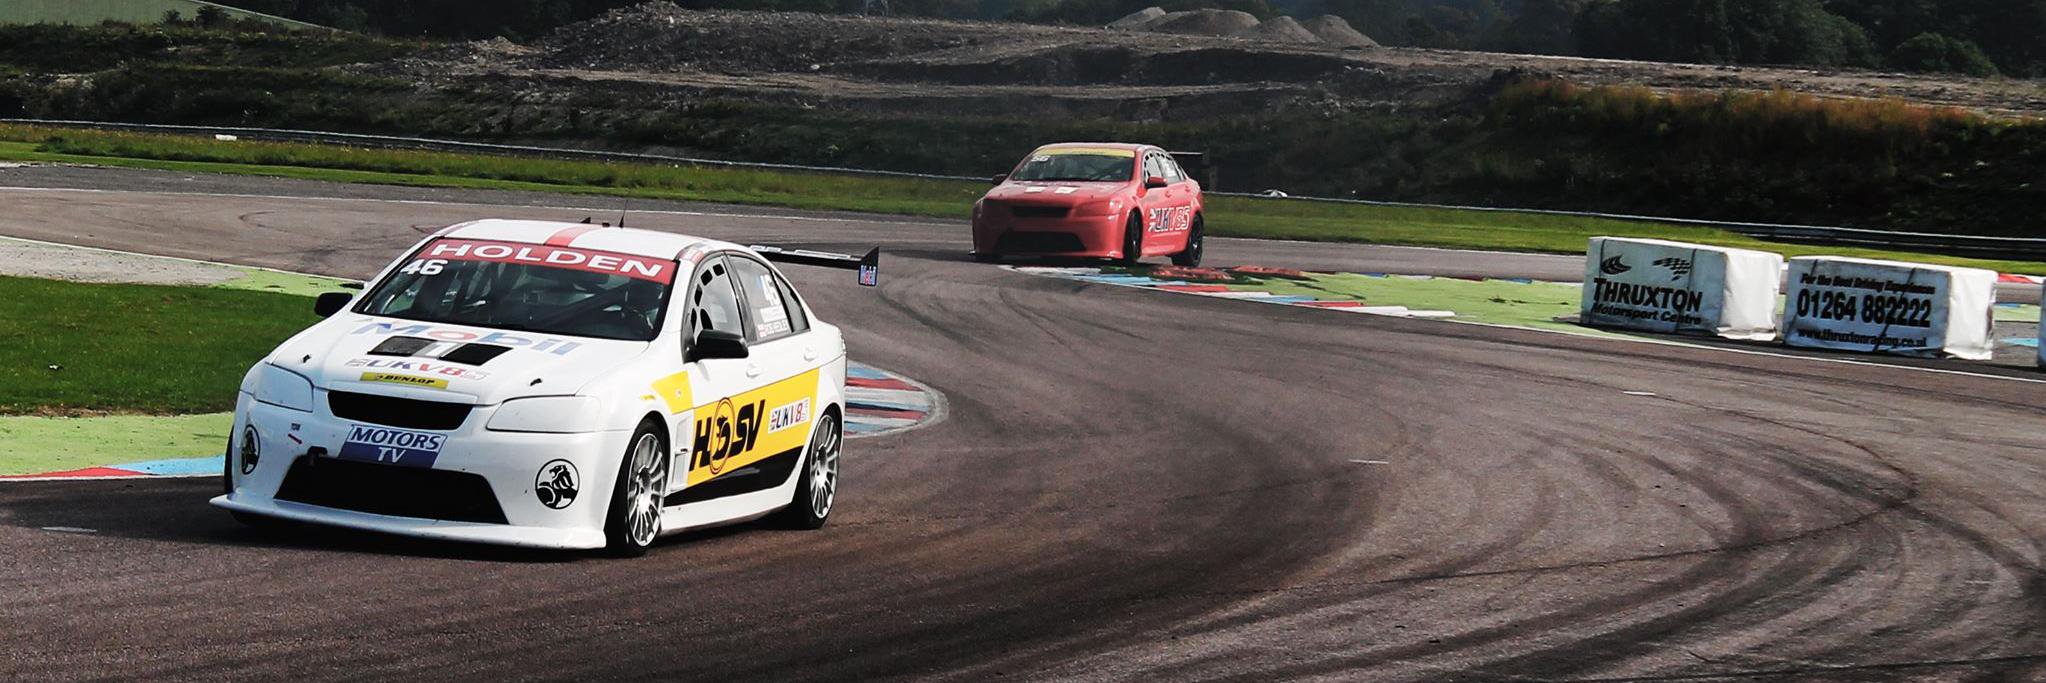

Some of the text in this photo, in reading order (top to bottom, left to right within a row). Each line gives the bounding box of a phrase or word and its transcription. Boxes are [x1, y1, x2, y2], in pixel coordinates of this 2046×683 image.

[400, 259, 448, 276] 46
[430, 243, 663, 278] HOLDEN
[1800, 273, 1816, 285] For
[1816, 274, 1831, 286] the
[1593, 277, 1703, 313] THRUXTON
[1592, 302, 1701, 325] Motorsport Centre
[1797, 288, 1932, 328] 01264 882222
[351, 322, 583, 355] Mobil
[385, 374, 436, 386] DUNLOP
[351, 427, 441, 450] MOTORS
[377, 447, 407, 464] TV
